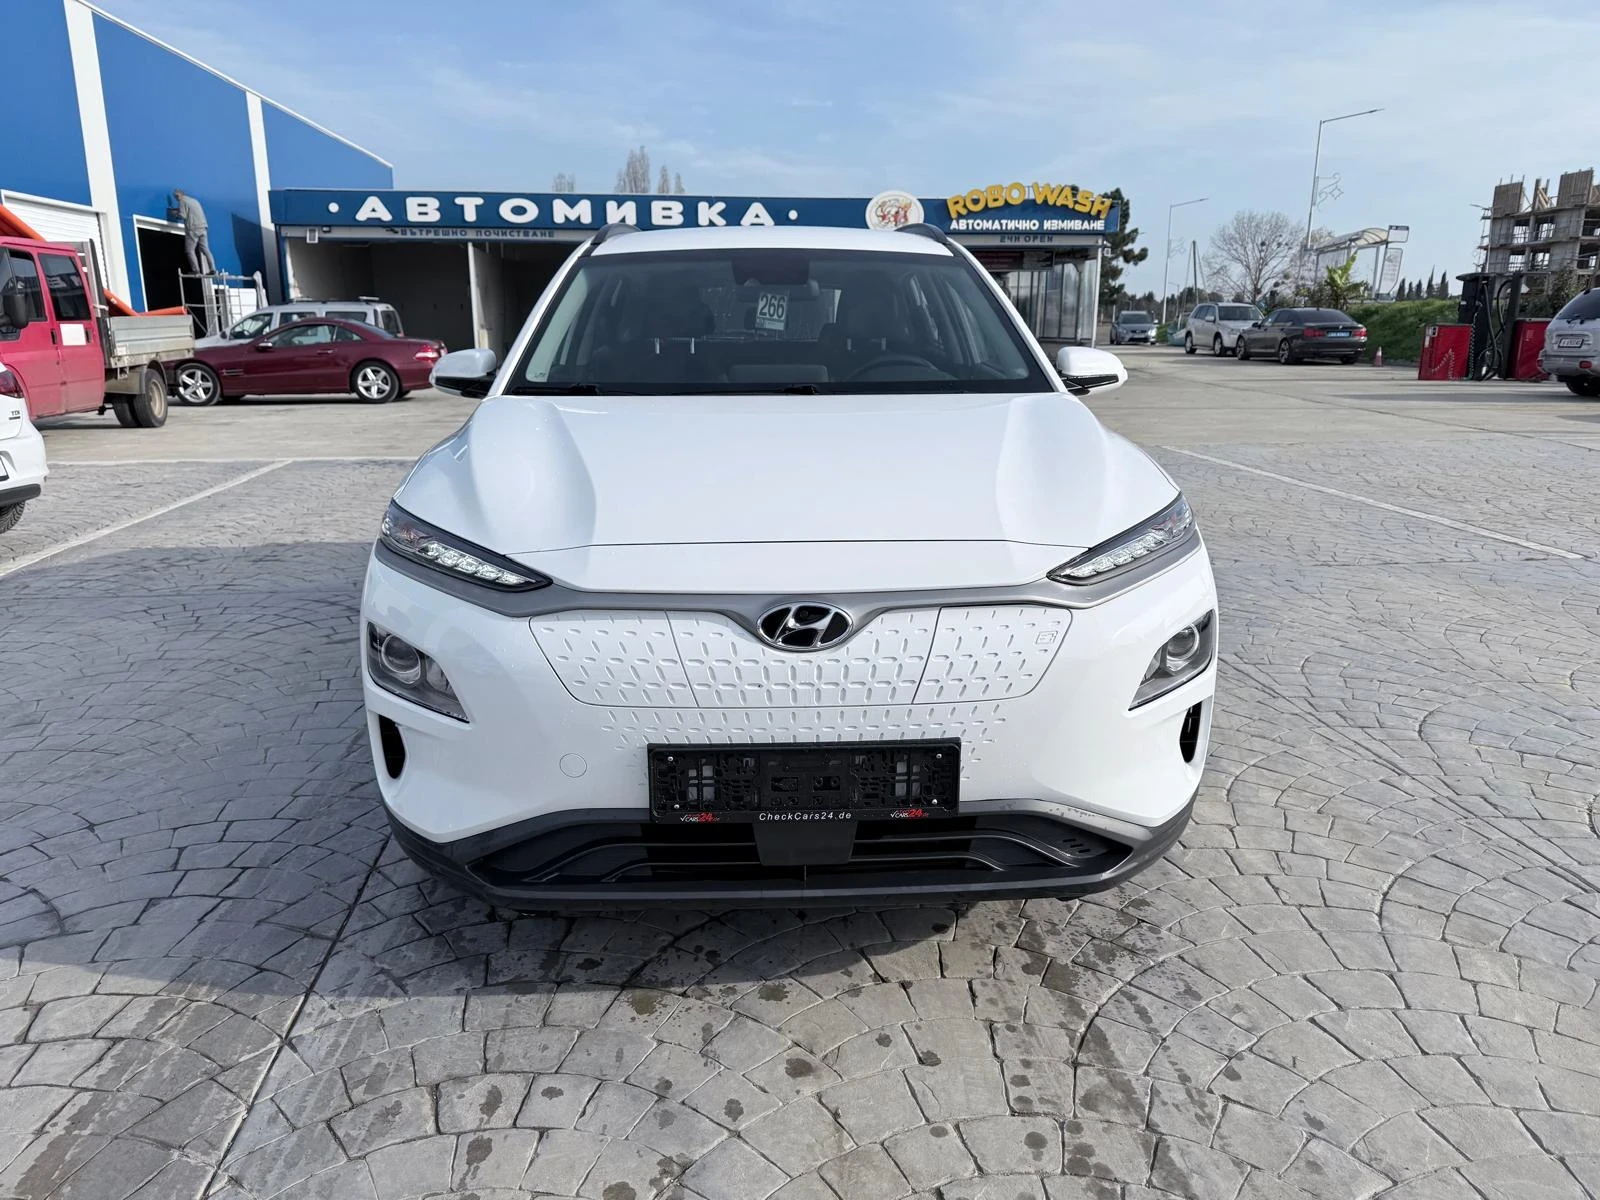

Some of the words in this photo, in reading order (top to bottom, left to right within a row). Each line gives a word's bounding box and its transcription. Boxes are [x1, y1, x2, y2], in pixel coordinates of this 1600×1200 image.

[947, 182, 1026, 219] ROBO
[1033, 182, 1112, 219] WASH
[355, 196, 775, 227] АВТОМИВКА
[400, 228, 468, 237] ВЪТРЕШНО
[475, 229, 555, 238] ПОЧИСТВАНЕ
[950, 219, 1039, 231] АВТОМАТИЧНО
[1044, 219, 1105, 231] ИЗМИВАНЕ
[759, 295, 786, 319] 266
[759, 811, 852, 821] CheckCars24.de
